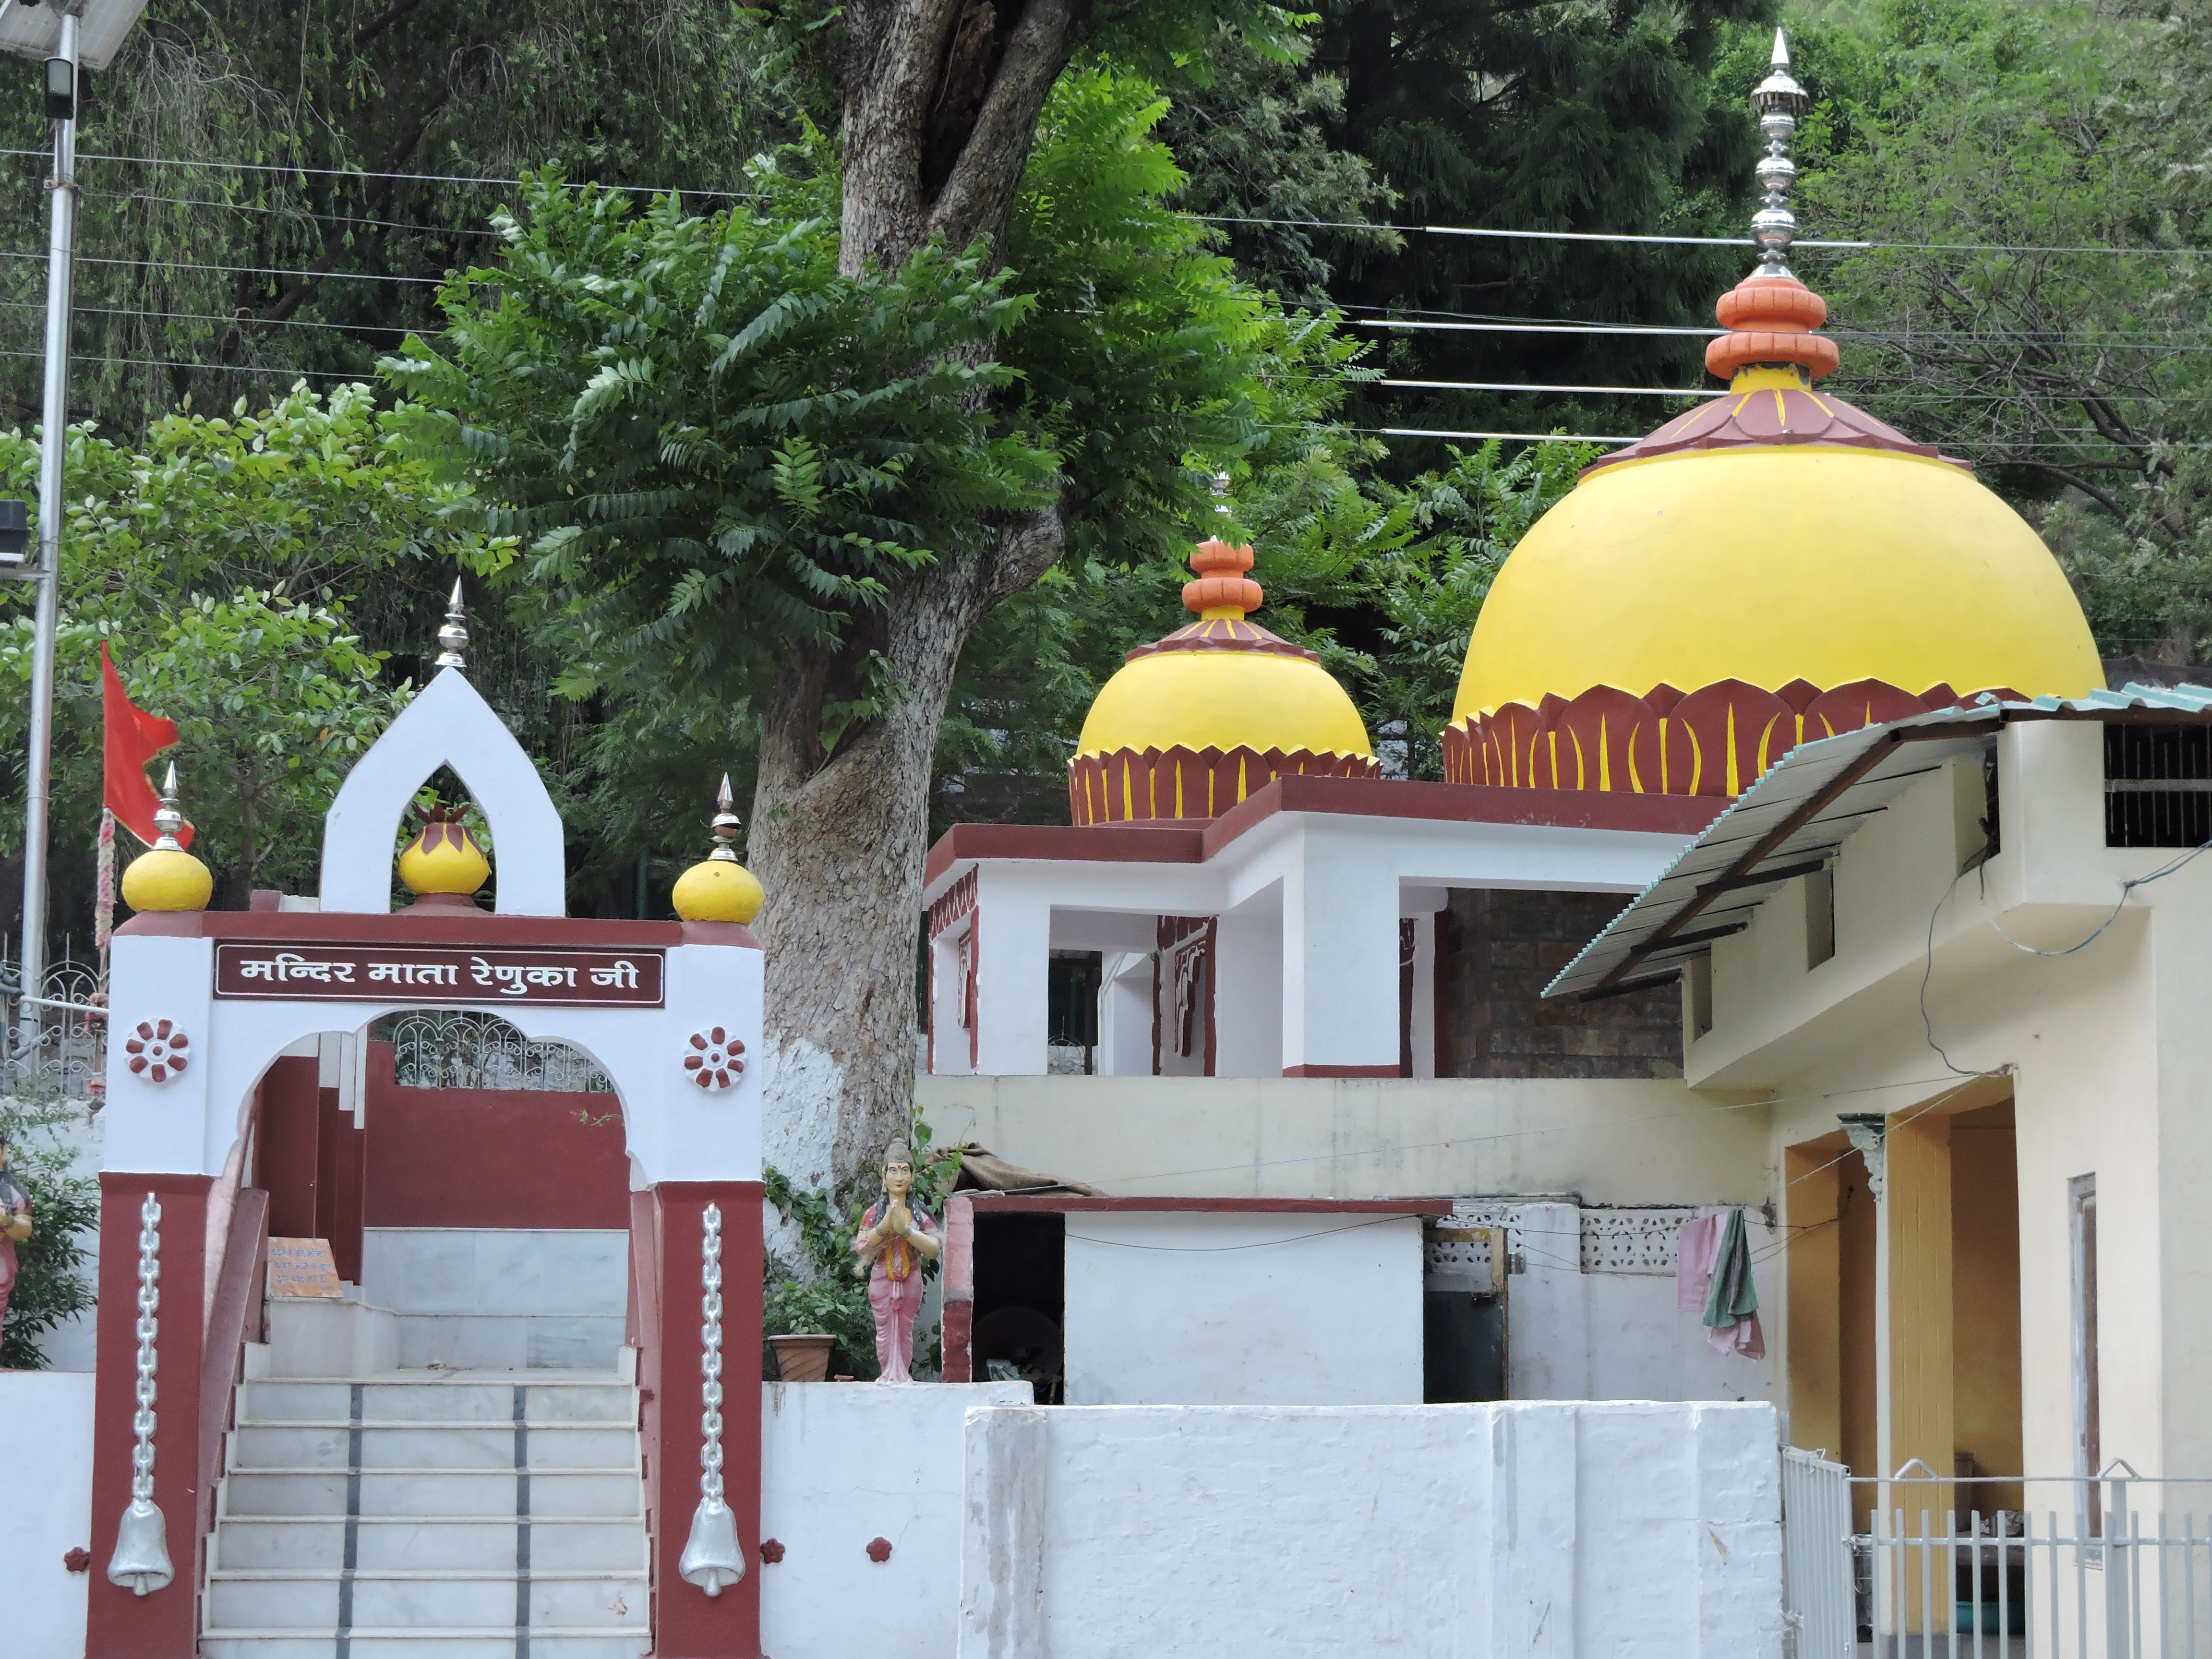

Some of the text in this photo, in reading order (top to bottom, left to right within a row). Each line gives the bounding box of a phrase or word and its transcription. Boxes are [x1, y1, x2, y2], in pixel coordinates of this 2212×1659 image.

[240, 953, 639, 995] मन्दिर माता रेणुका जी
